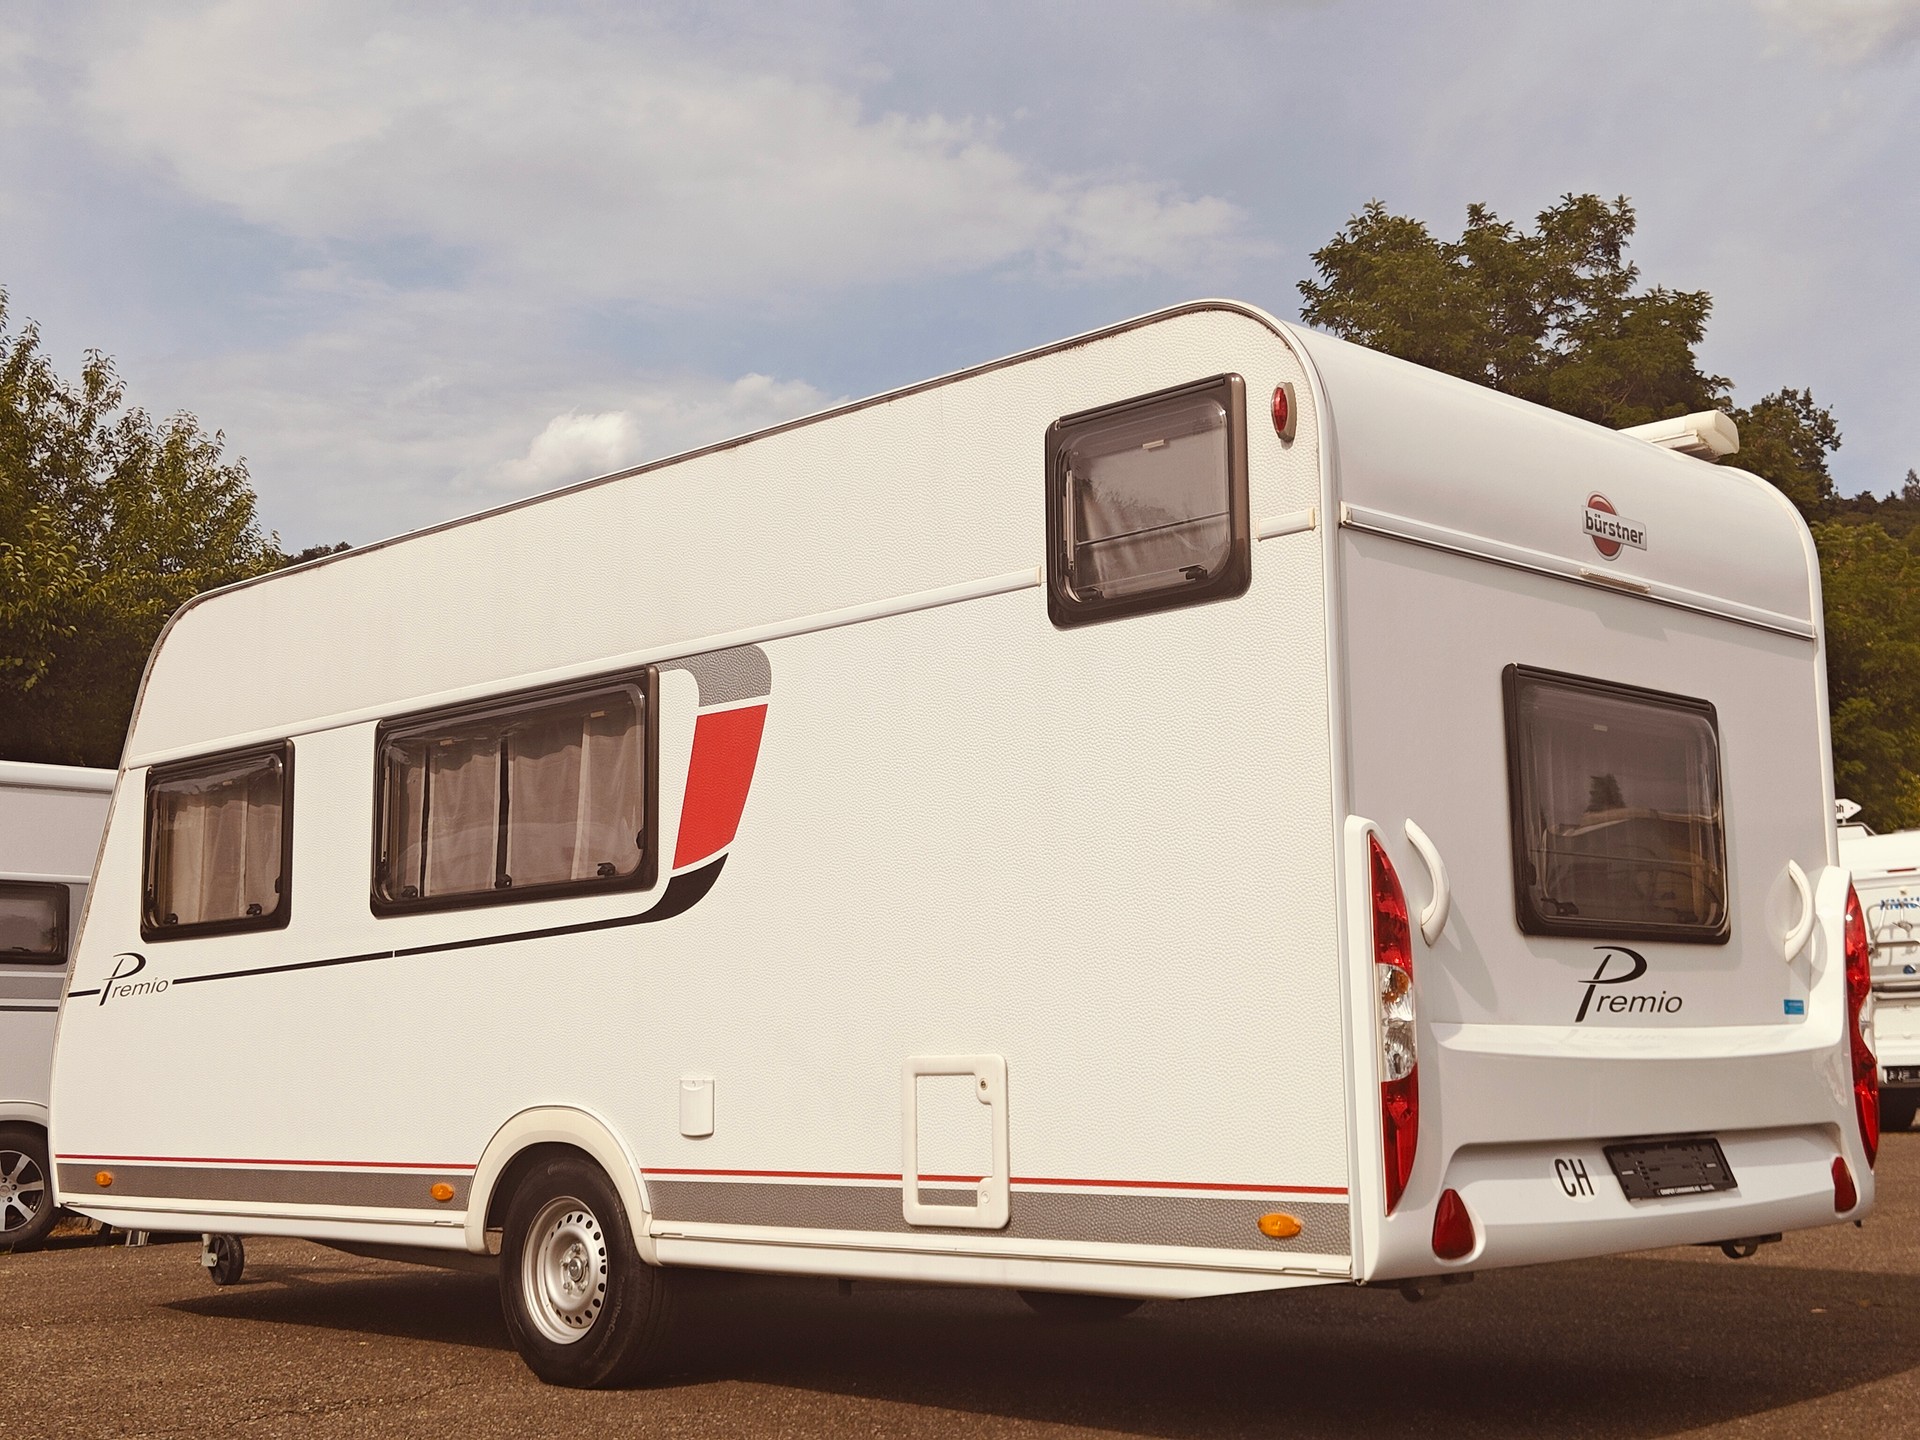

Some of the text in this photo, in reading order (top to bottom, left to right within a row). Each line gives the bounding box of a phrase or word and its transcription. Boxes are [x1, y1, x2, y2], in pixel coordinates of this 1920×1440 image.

[1585, 510, 1643, 544] bürstner
[99, 952, 169, 1006] Premio
[1575, 946, 1683, 1022] Premio
[1554, 1158, 1595, 1197] CH
